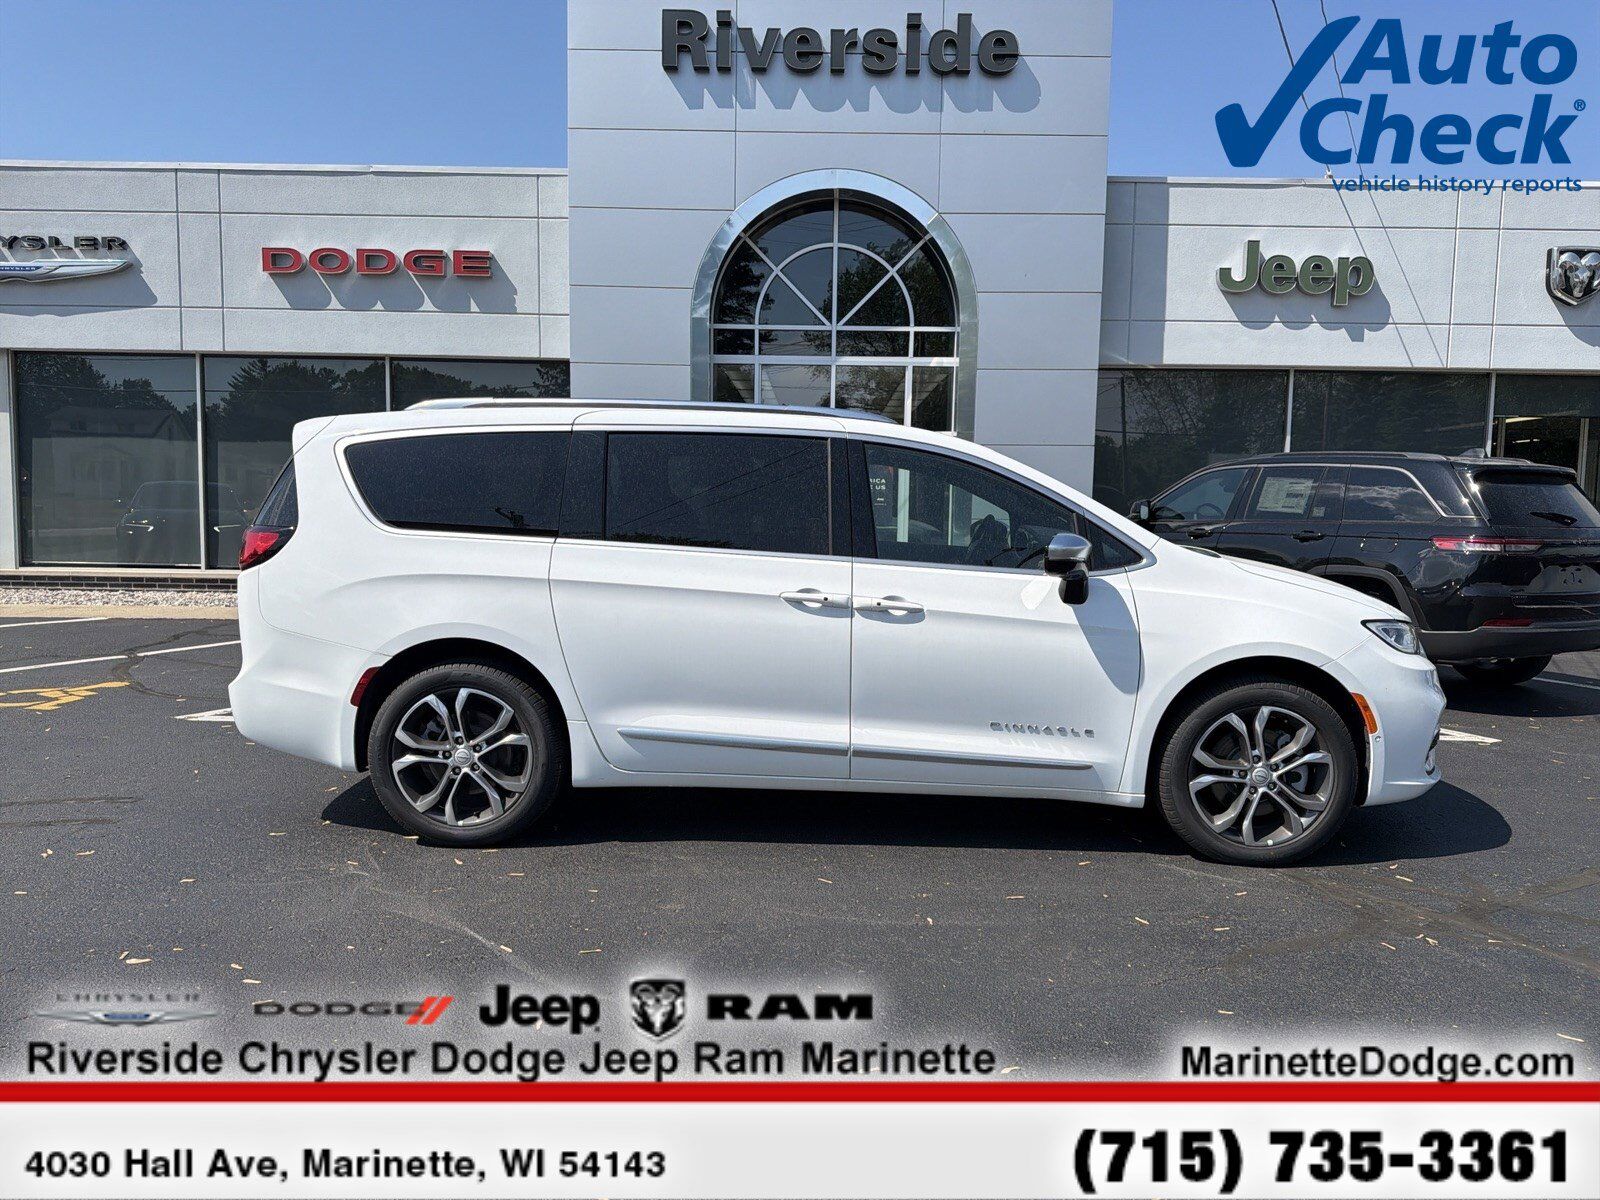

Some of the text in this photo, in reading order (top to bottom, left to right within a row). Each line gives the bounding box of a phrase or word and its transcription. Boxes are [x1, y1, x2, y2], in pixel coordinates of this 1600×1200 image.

[662, 9, 1019, 75] Riverside
[262, 247, 492, 277] DODGE
[1216, 239, 1375, 306] Jeep
